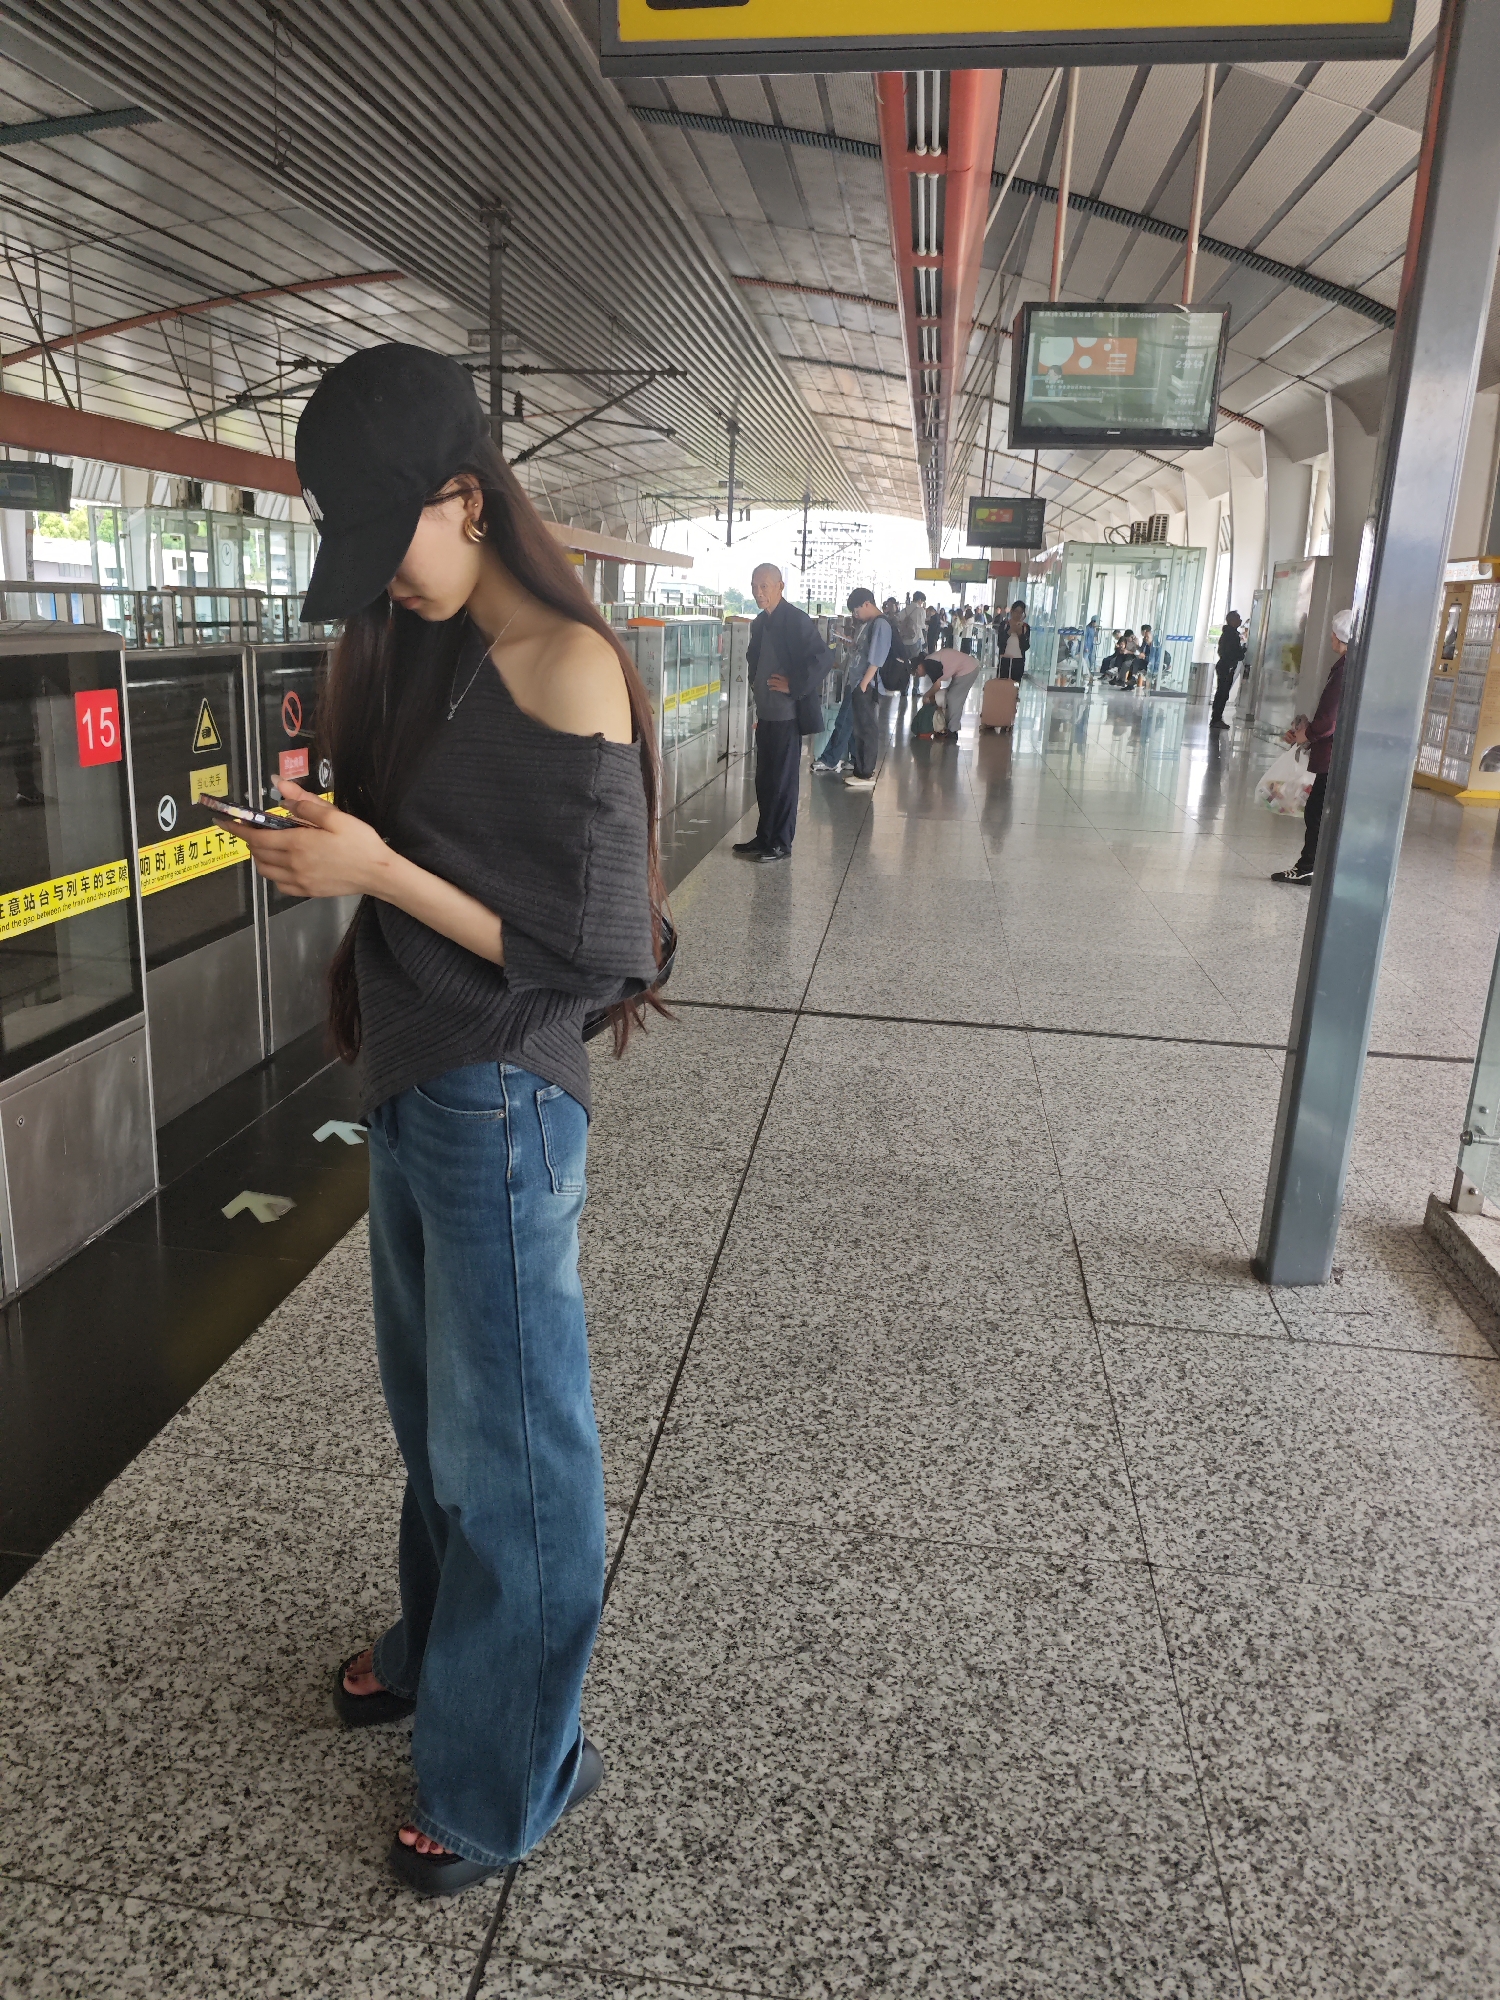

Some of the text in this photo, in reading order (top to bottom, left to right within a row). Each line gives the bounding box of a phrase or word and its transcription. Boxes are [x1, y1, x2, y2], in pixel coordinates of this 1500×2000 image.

[1175, 360, 1204, 369] 2分钟
[82, 706, 115, 750] 15
[11, 919, 21, 928] the
[23, 916, 35, 927] gap
[37, 906, 61, 920] between
[62, 902, 71, 912] the
[72, 898, 85, 908] train
[86, 894, 97, 904] and
